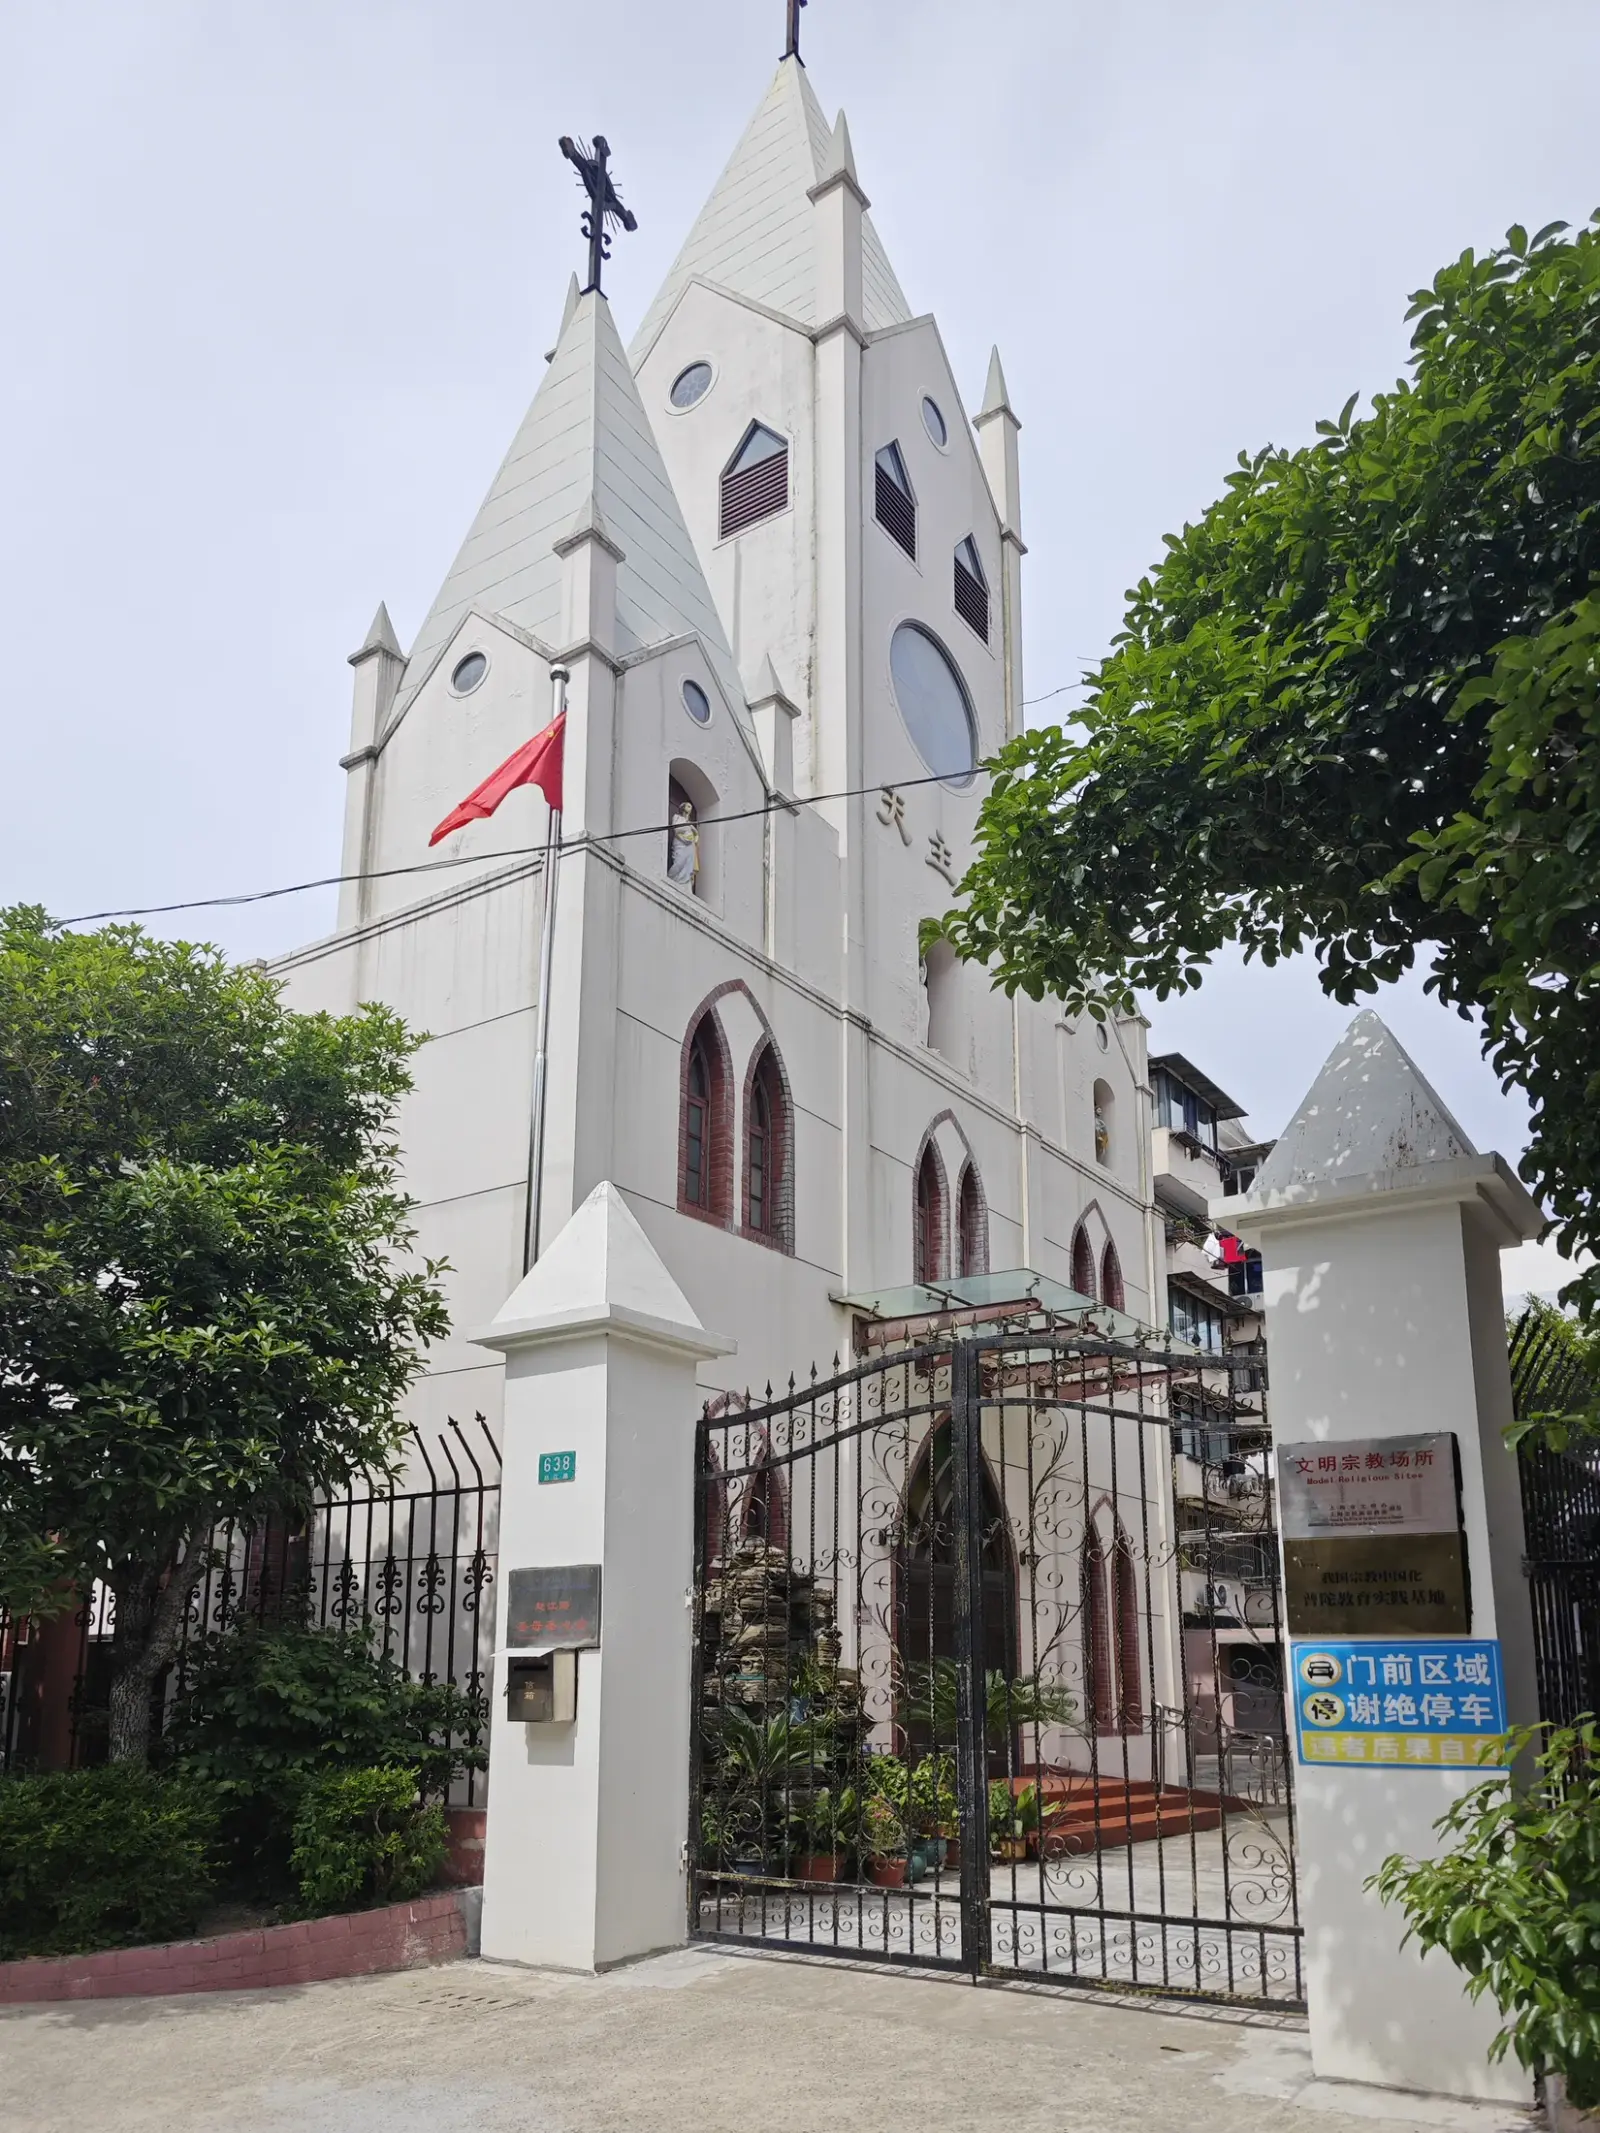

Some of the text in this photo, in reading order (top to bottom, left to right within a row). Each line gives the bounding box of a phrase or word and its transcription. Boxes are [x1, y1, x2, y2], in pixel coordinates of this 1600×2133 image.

[876, 781, 958, 888] 天主
[543, 1455, 570, 1473] 638
[1295, 1449, 1434, 1474] 文明宗教场所
[1307, 1472, 1424, 1485] Model Religious Sites
[1321, 1570, 1422, 1584] 我国宗教中国化
[1303, 1588, 1446, 1607] 普陀教育实践基地
[1346, 1653, 1492, 1685] 门前区域
[1348, 1692, 1494, 1727] 谢绝停车
